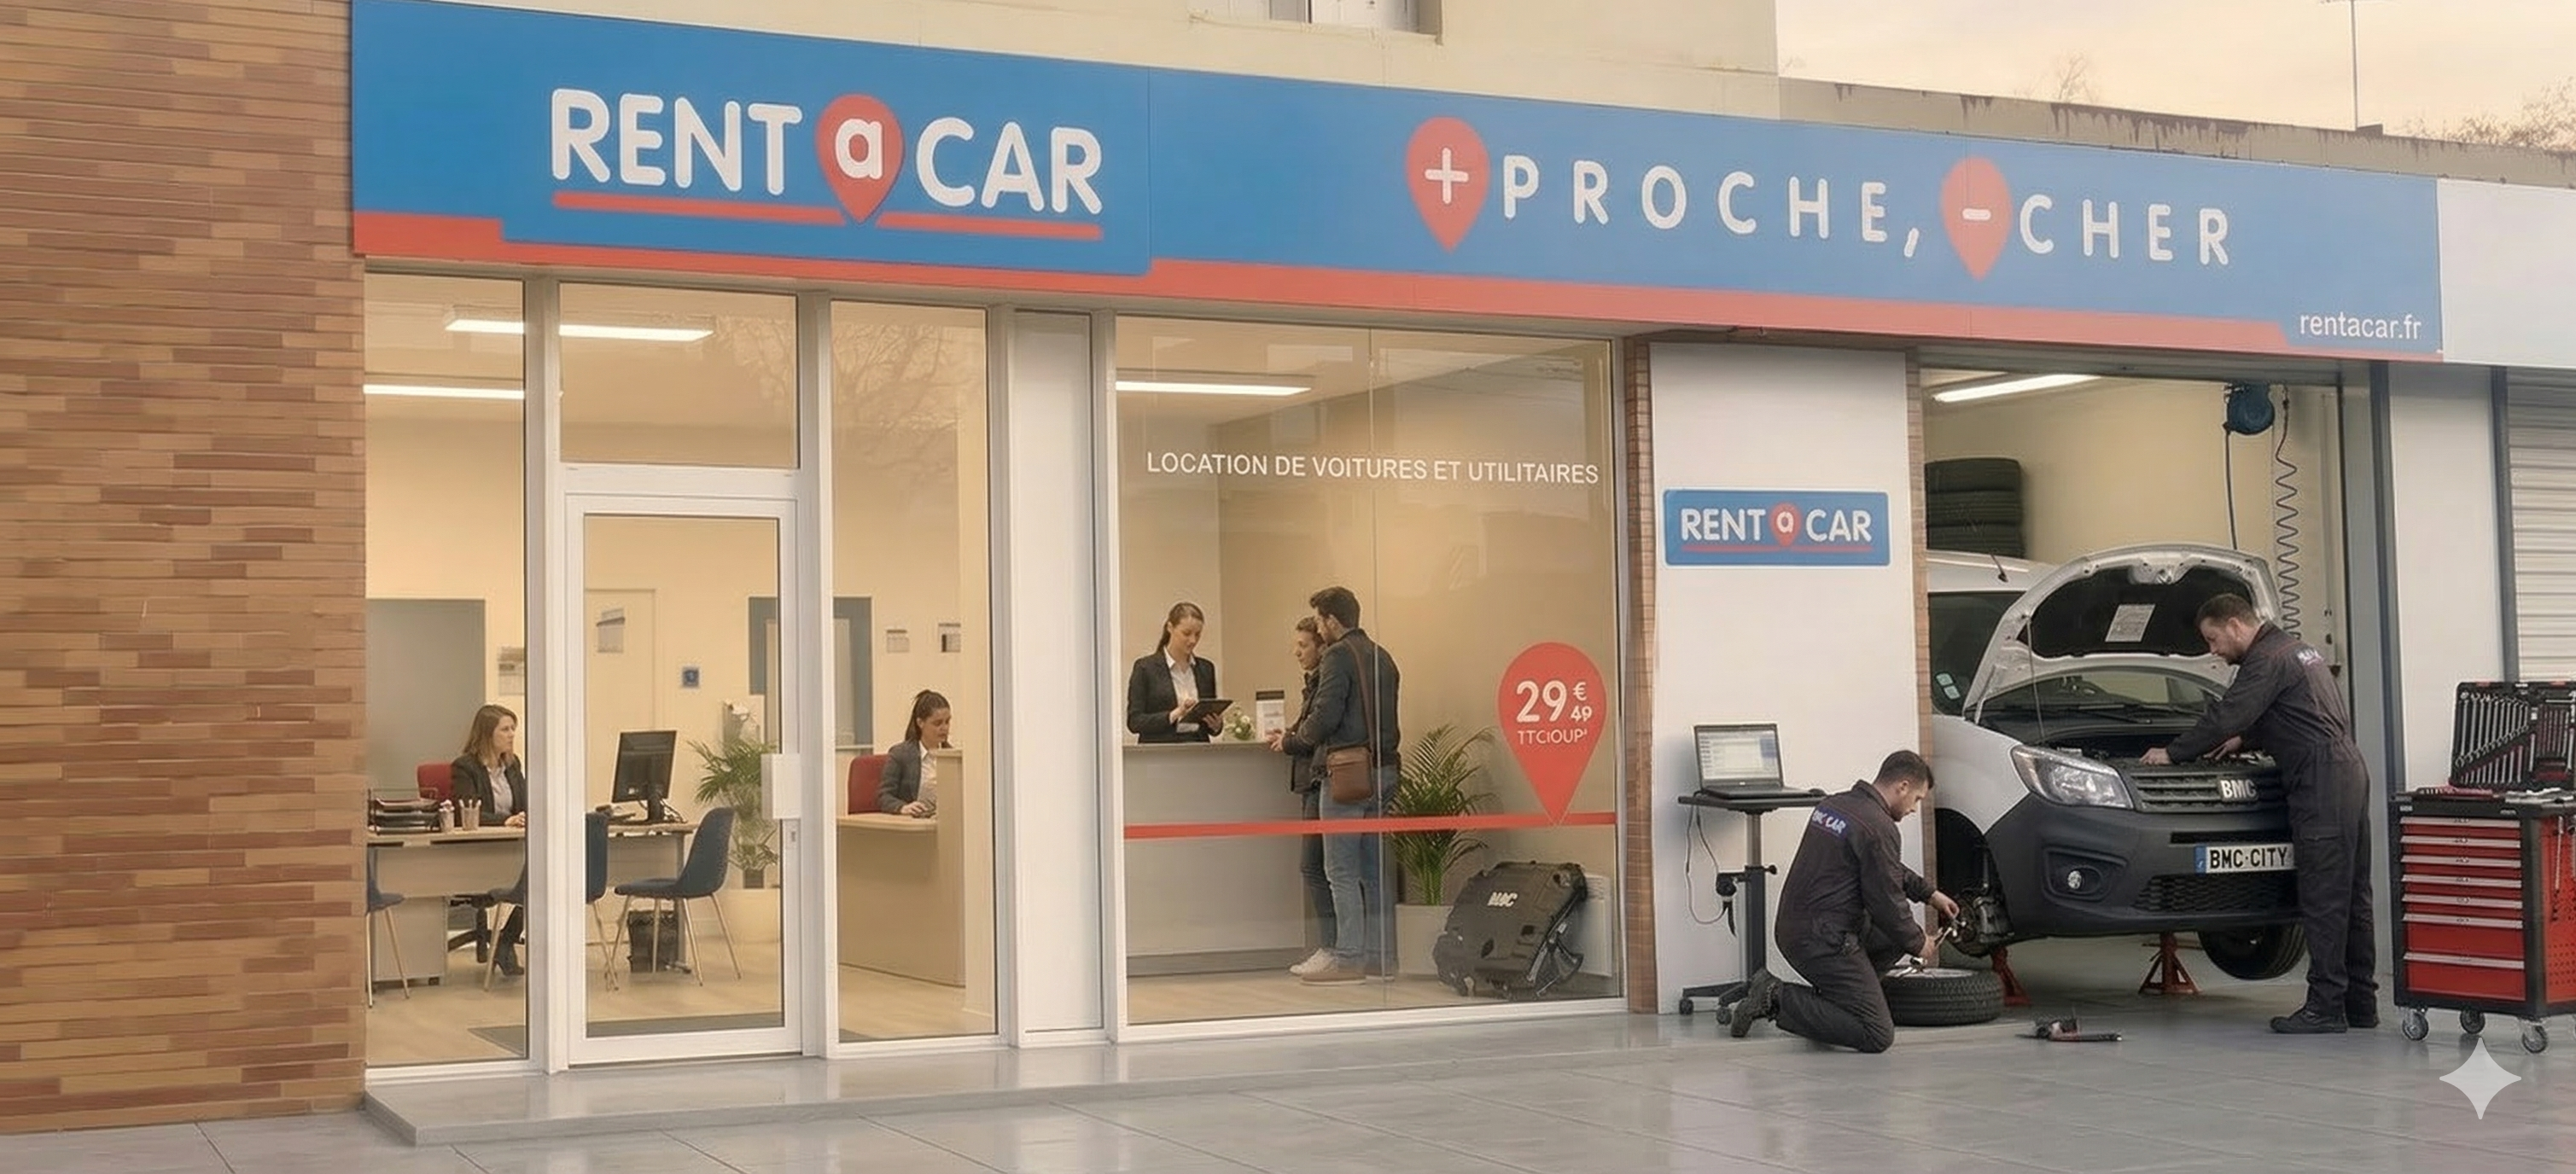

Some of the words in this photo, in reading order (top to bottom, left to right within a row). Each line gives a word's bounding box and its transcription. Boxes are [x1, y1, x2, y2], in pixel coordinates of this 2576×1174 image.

[551, 88, 802, 195] RENT
[835, 118, 883, 179] a
[916, 116, 1103, 214] CAR
[1503, 154, 1920, 258] PROCHE,
[2019, 194, 2229, 265] CHER
[2300, 311, 2422, 340] rentacar.fr
[1147, 452, 1267, 474] LOCATION
[1275, 456, 1306, 476] DE
[1313, 456, 1428, 479] VOITURES
[1434, 461, 1461, 479] ET
[1468, 462, 1599, 484] UTILITAIRES
[1681, 509, 1766, 541] RENT
[1776, 511, 1794, 533] a
[1806, 509, 1873, 542] CAR
[2219, 779, 2257, 799] BMC
